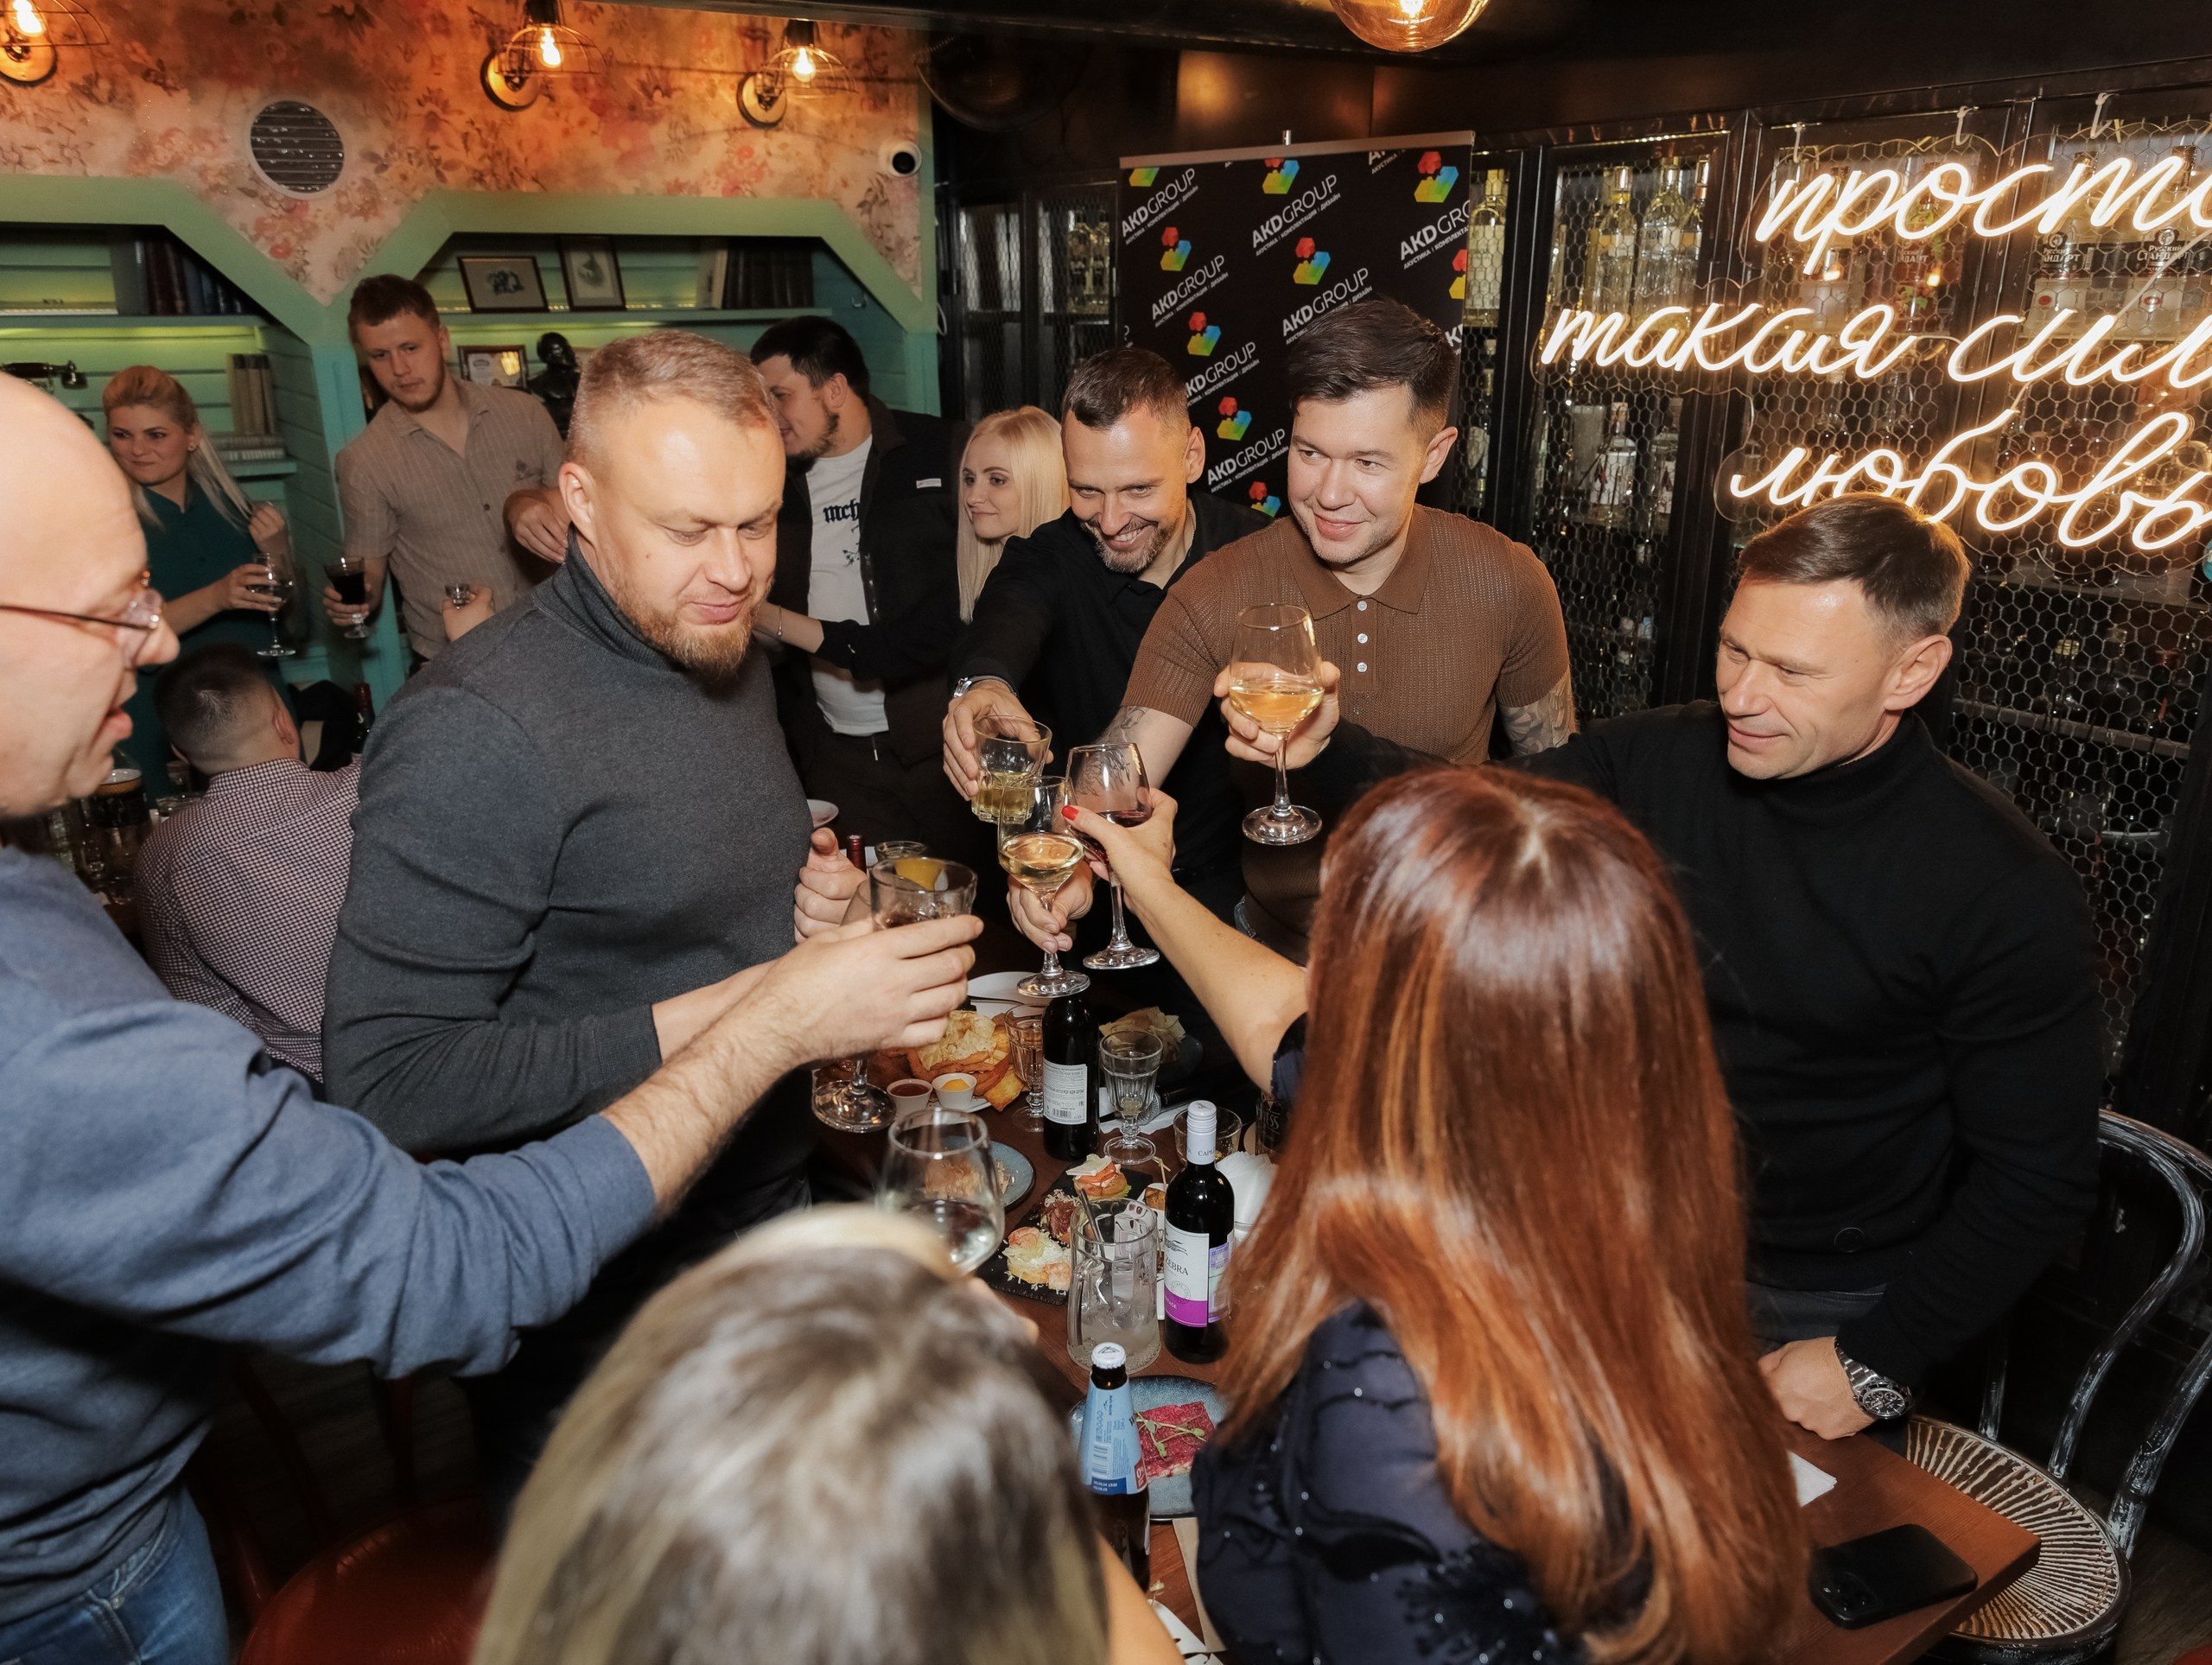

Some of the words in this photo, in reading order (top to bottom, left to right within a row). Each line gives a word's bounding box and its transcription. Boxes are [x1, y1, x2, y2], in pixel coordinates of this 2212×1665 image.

[1122, 168, 1196, 238] AKDGROUP
[1252, 175, 1338, 249] AKDGROUP
[1152, 255, 1225, 321] AKDGROUP
[1403, 249, 1432, 270] АКУСТИКА
[1282, 268, 1369, 337] AKDGROUP
[1185, 341, 1256, 398] KDGROUP
[1541, 302, 1917, 379] такая
[1207, 429, 1286, 486] AKDGROUP
[1730, 409, 2212, 550] любовь
